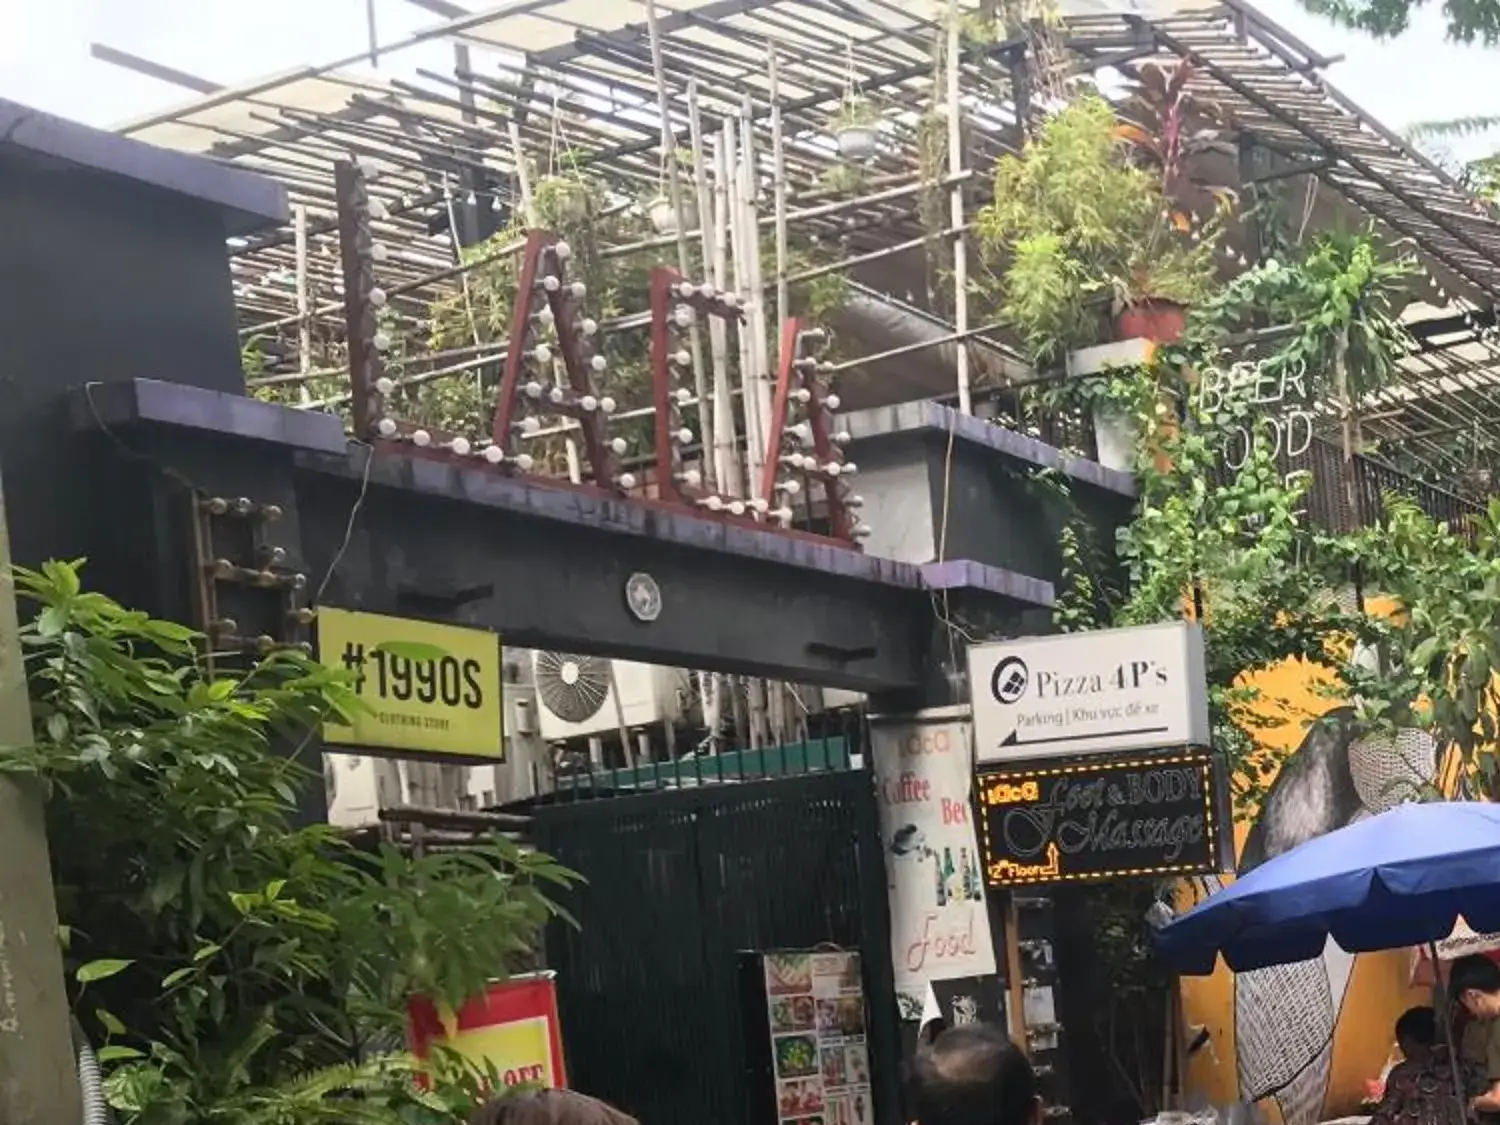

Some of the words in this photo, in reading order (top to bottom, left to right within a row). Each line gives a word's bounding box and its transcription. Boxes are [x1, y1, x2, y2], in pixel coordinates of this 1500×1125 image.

[1223, 410, 1313, 470] OOD
[1036, 670, 1102, 698] Pizza
[1110, 660, 1169, 689] 4P's
[1016, 712, 1063, 728] Parking
[1127, 767, 1203, 807] BODY
